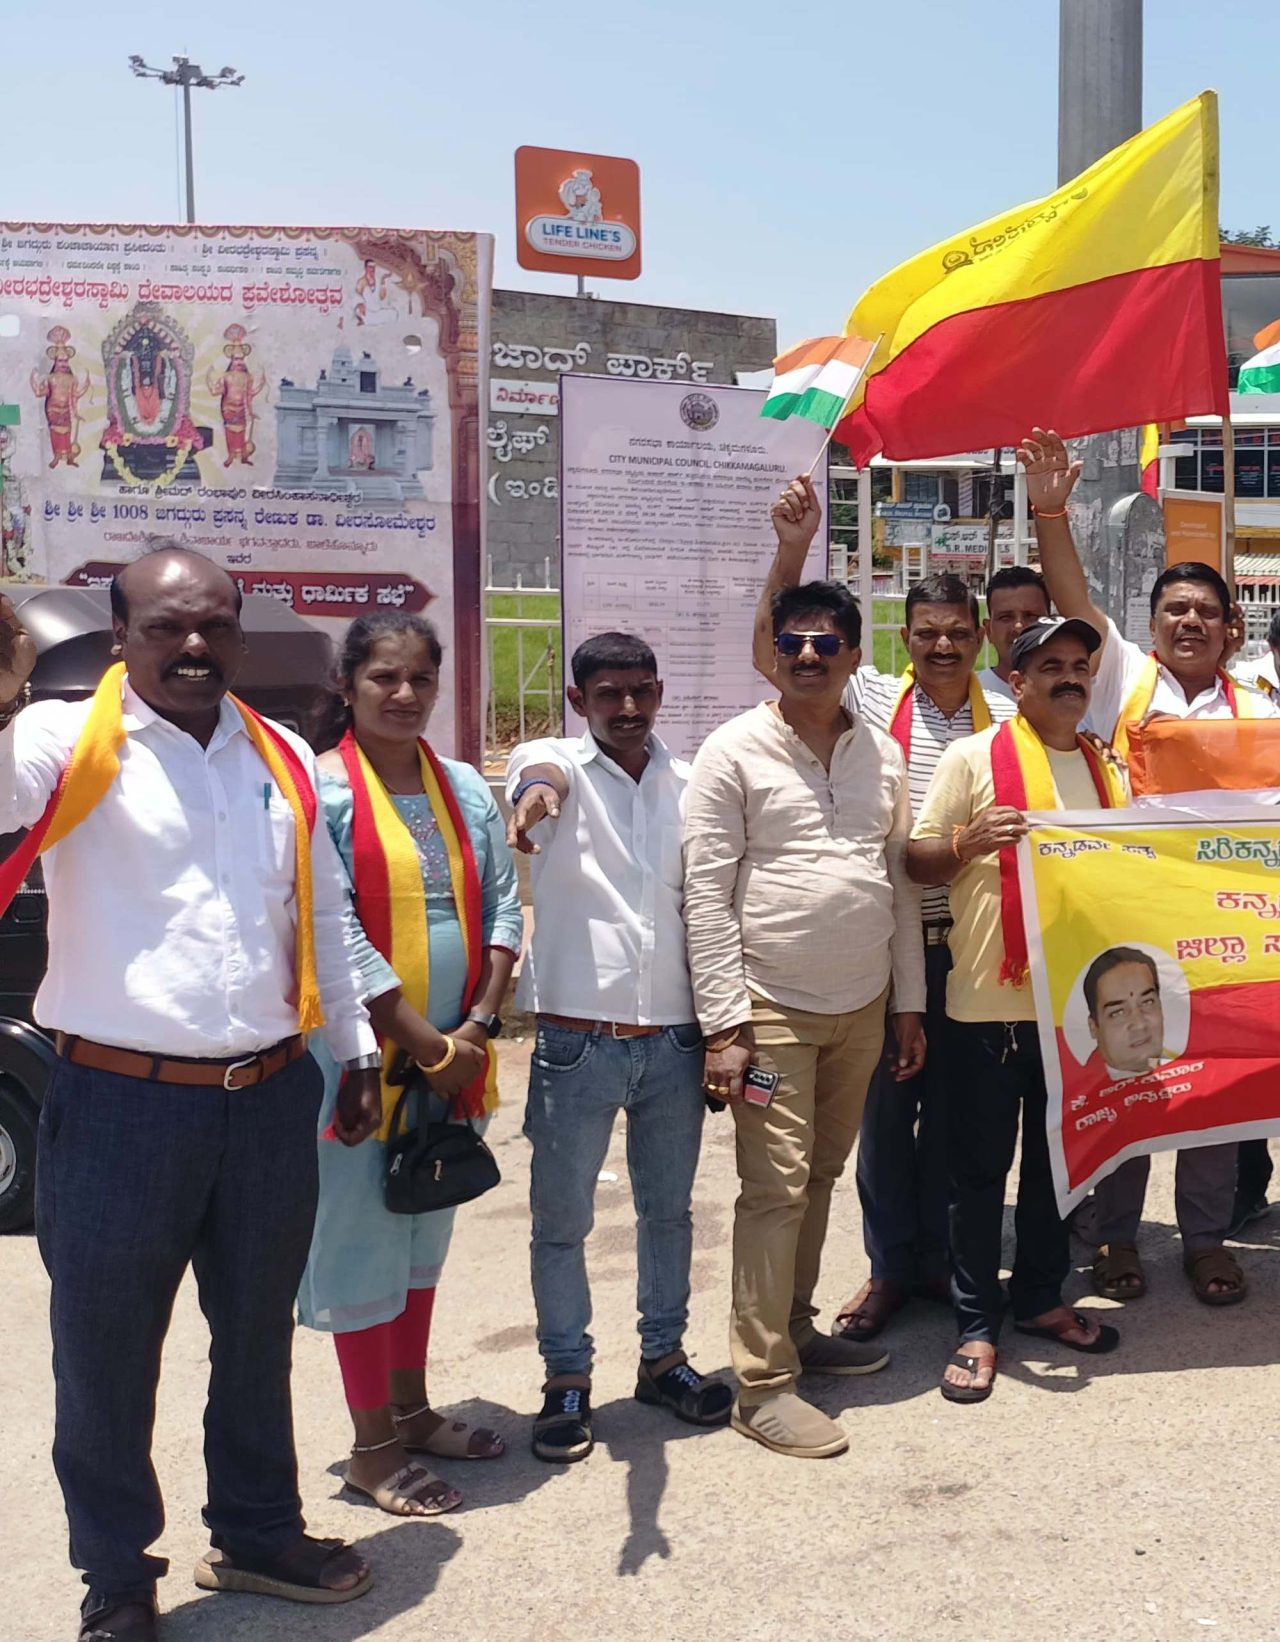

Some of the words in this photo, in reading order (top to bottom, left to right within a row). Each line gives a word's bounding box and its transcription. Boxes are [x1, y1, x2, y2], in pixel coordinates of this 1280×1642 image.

[543, 223, 573, 238] LIFE
[576, 227, 621, 243] LINE'S
[543, 238, 580, 248] TENDER
[582, 241, 622, 252] CHICKEN
[138, 278, 233, 303] ದೇವಾಲಯದ
[242, 281, 343, 313] ಪ್ರವೇಶೋತ್ಸವ
[492, 342, 592, 372] ಜಾದ್
[606, 352, 714, 383] ಪಾರ್ಕ್
[609, 454, 627, 464] CITY
[628, 455, 673, 467] MUNICIPAL
[44, 500, 60, 522] ಶ್ರೀ
[67, 501, 83, 522] ಶ್ರೀ
[89, 502, 106, 524] ಶ್ರೀ
[113, 504, 149, 520] 1008
[155, 506, 206, 529] ಜಗದ್ಗುರು
[213, 508, 248, 529] ಪ್ರಸನ್ನ
[254, 507, 299, 526] ರೇಣುಕ
[306, 513, 328, 527] ಡಾ.
[335, 512, 436, 538] ವೀರಸೋಮೇಶ್ವರ
[965, 544, 1010, 553] MEDIS
[301, 583, 369, 605] ಧಾರ್ಮಿಕ
[1176, 935, 1247, 964] ಜಿಲ್ಲಾ
